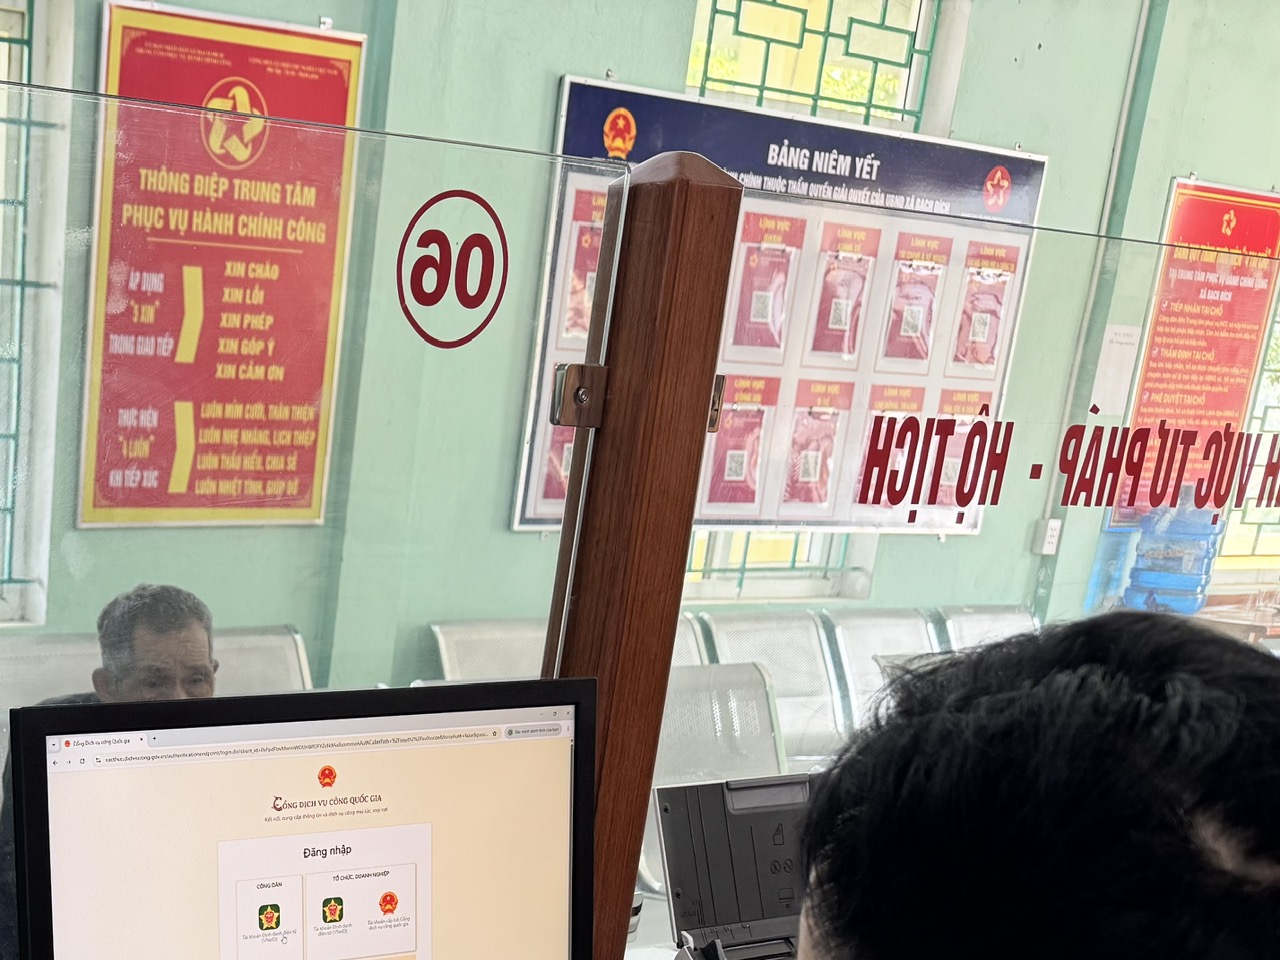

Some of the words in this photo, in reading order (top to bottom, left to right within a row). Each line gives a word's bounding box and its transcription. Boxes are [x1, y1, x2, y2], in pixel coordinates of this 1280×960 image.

[768, 139, 809, 168] BẢNG
[812, 153, 851, 176] NIÊM
[855, 153, 881, 180] YẾT
[140, 165, 189, 194] THÔNG
[194, 172, 229, 201] ĐIỆP
[233, 179, 281, 204] TRUNG
[285, 181, 316, 207] TÂM
[122, 204, 164, 232] PHỤC
[169, 208, 189, 235] VỤ
[192, 208, 234, 235] HÀNH
[238, 212, 282, 240] CHÍNH
[286, 217, 326, 244] CÔNG
[300, 800, 316, 809] DỊCH
[329, 796, 348, 805] CÔNG
[350, 793, 368, 805] QUỐC
[370, 794, 382, 803] GIA
[303, 847, 327, 858] Đăng
[330, 845, 352, 856] nhập
